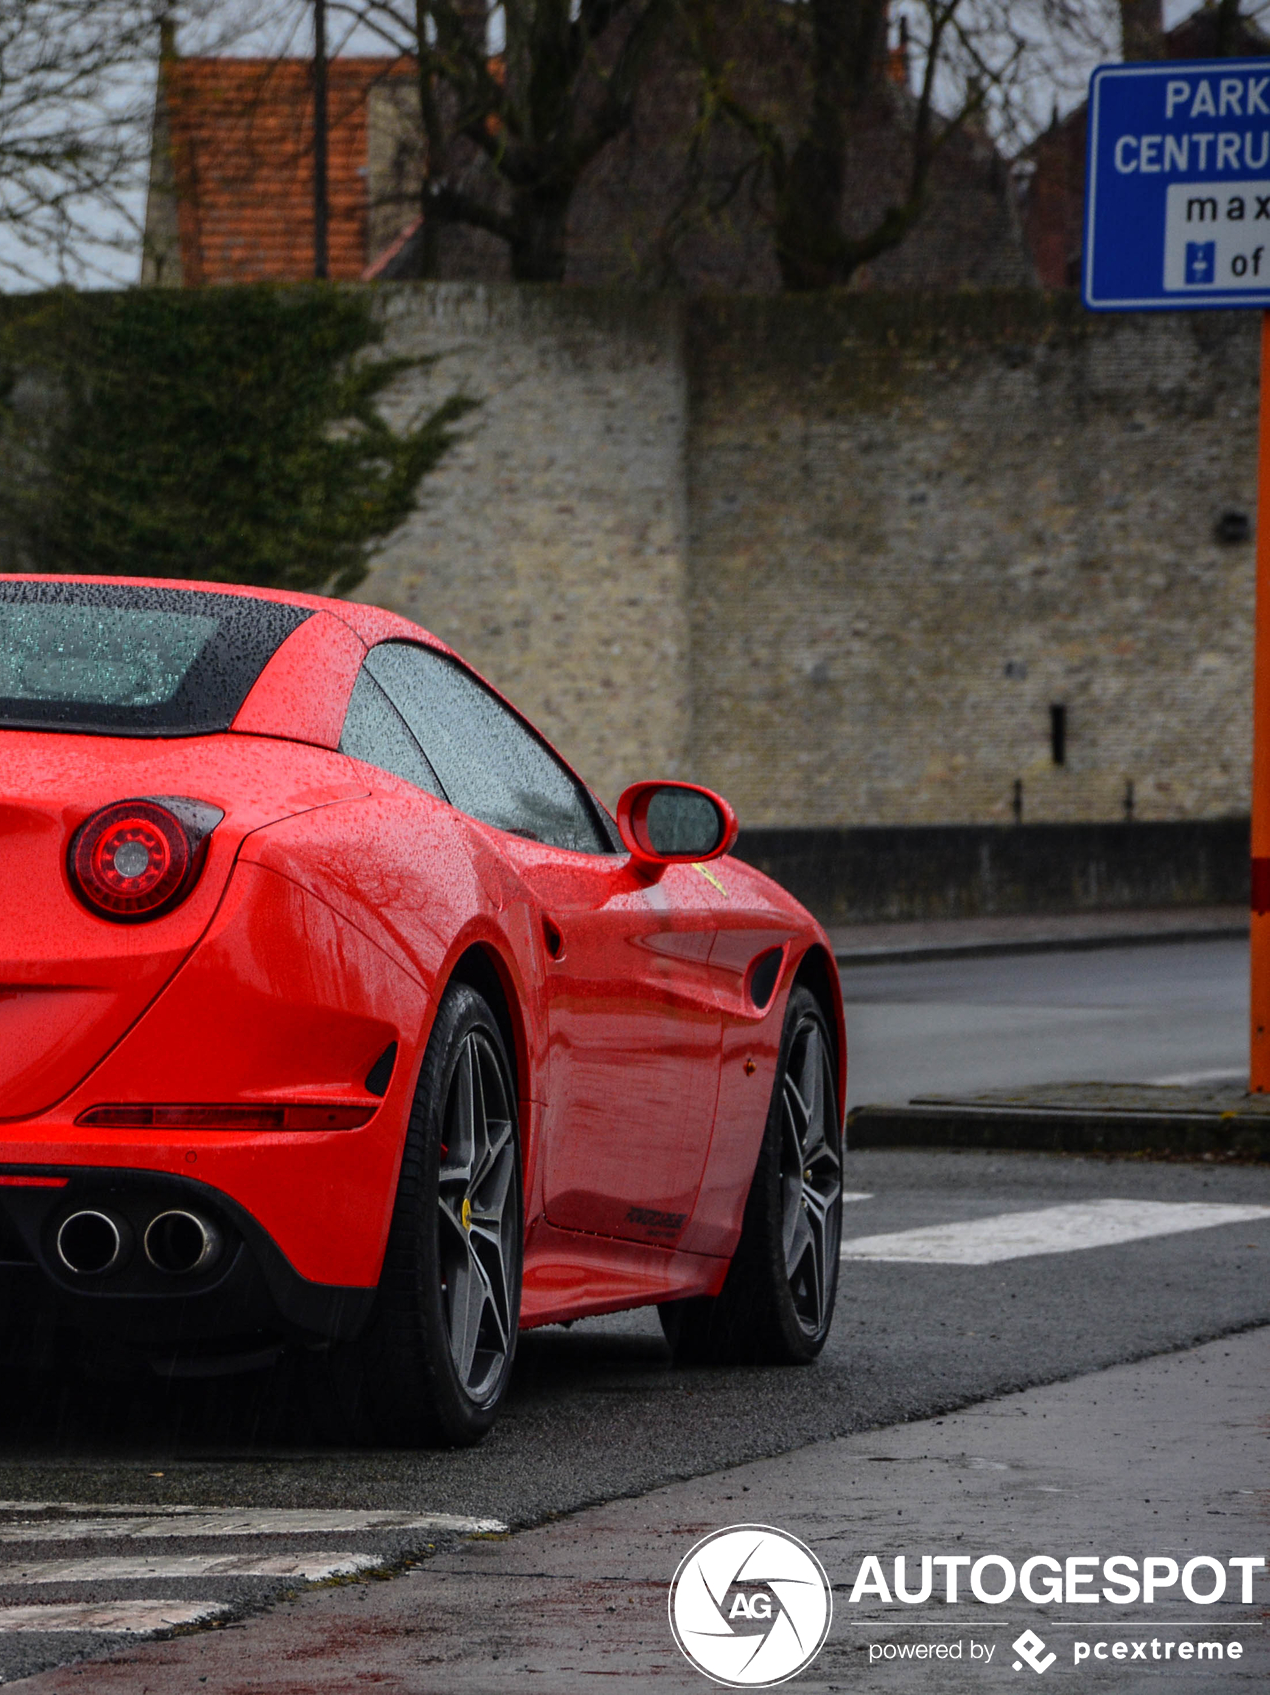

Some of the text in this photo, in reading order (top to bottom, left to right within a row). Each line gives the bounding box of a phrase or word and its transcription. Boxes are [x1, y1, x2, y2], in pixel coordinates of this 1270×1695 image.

[1165, 77, 1270, 119] PARK
[1114, 131, 1270, 174] CENTRU
[1186, 195, 1270, 222] max
[1231, 246, 1265, 277] of
